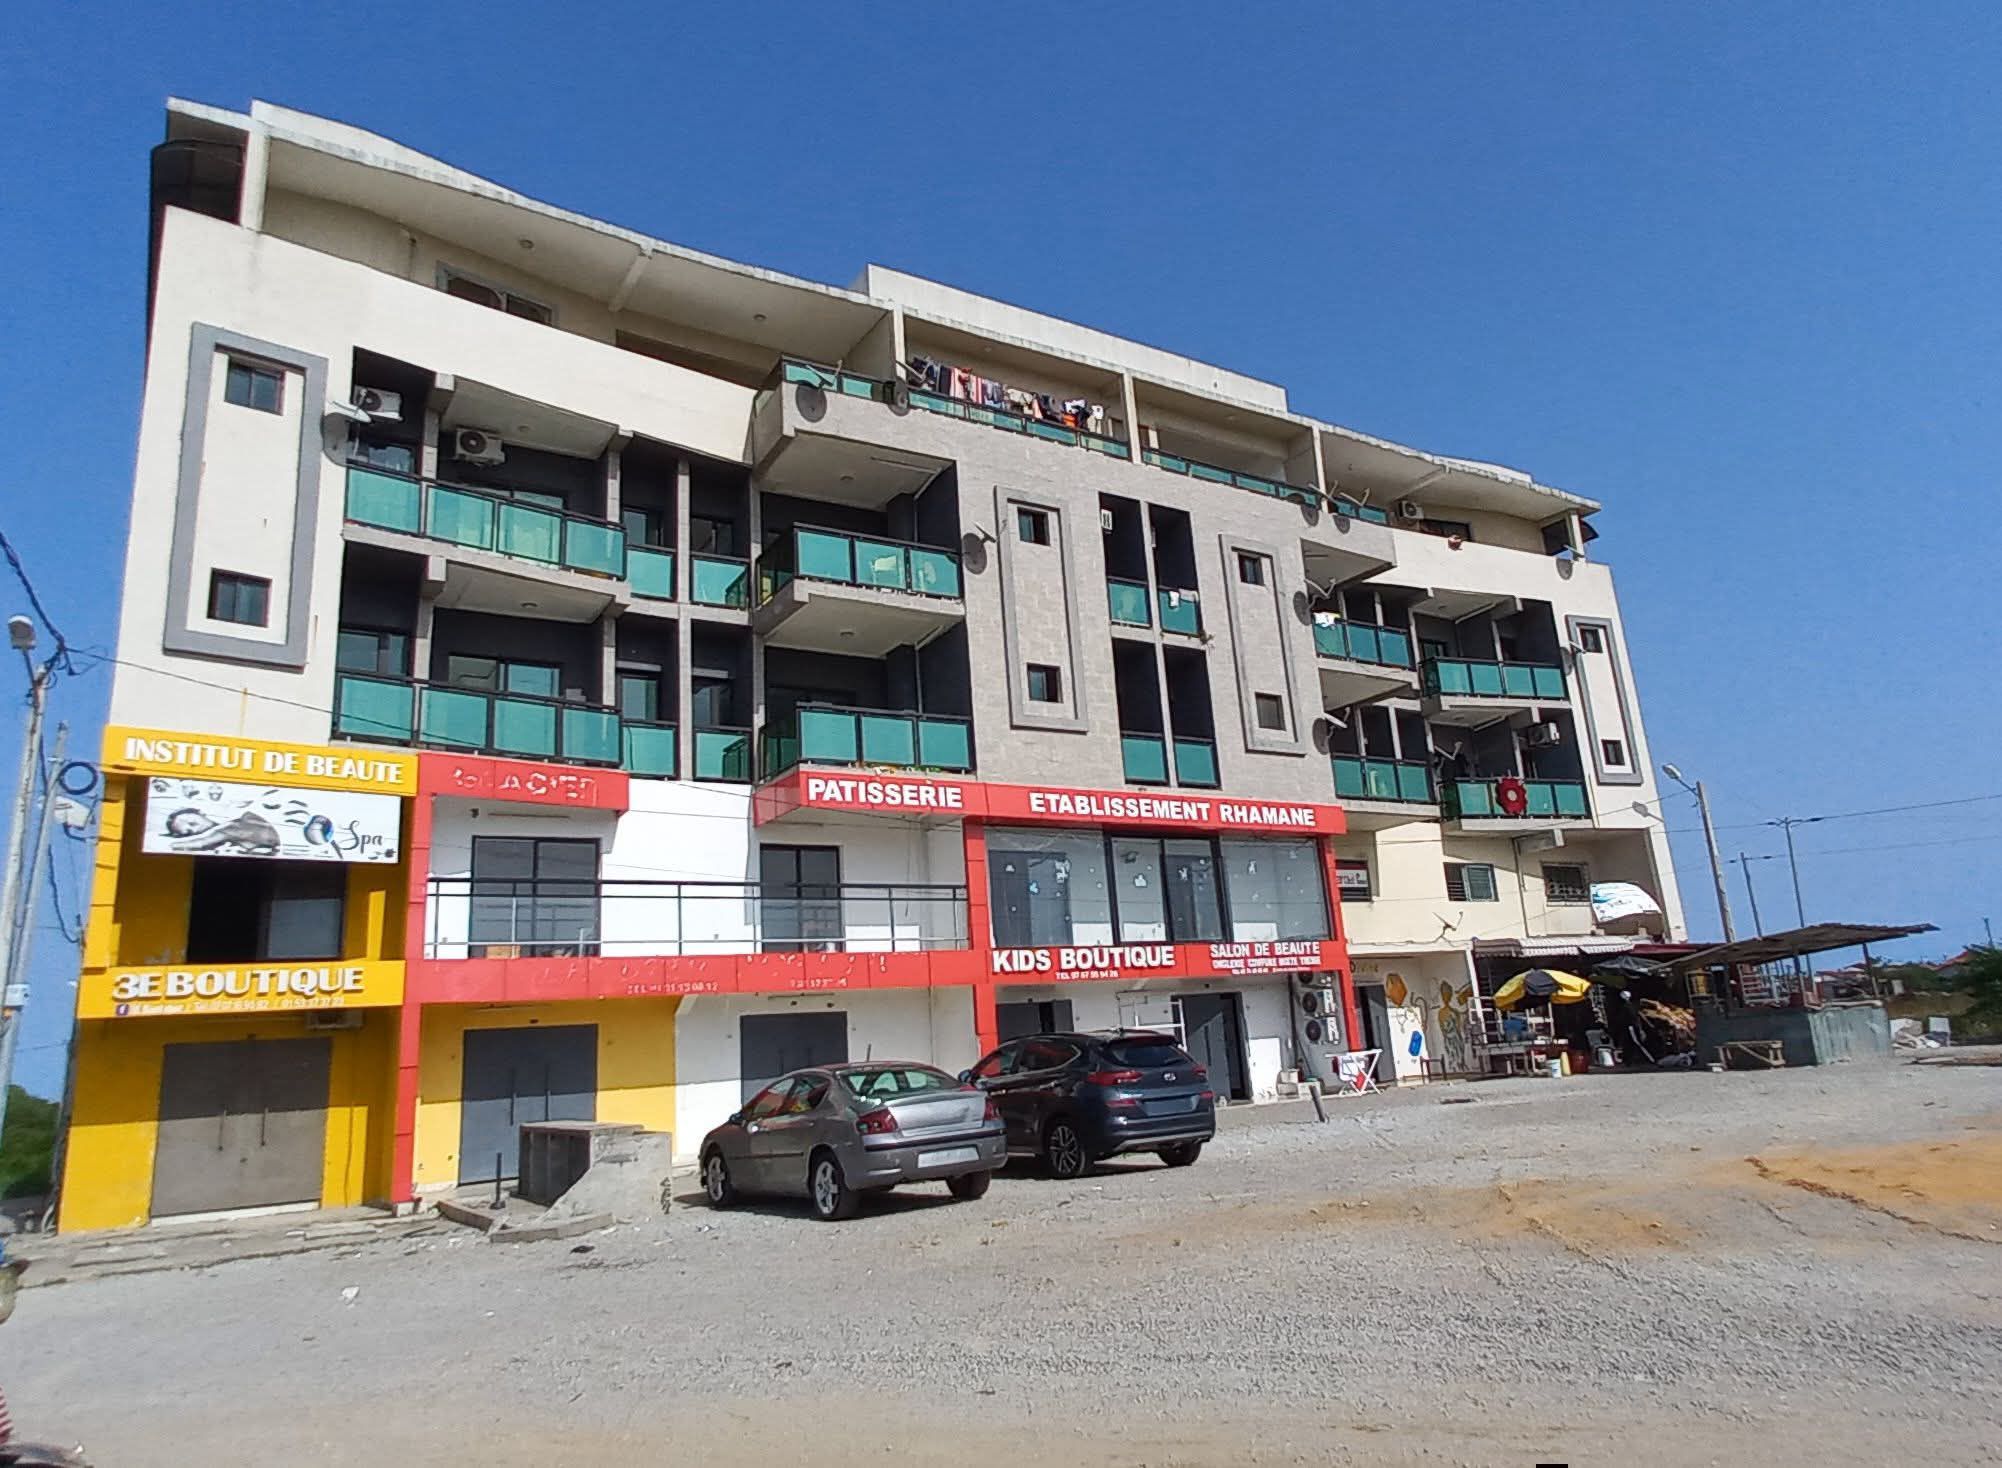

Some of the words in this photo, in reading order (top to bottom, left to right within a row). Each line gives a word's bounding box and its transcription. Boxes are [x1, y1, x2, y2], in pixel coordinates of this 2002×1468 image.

[124, 737, 256, 770] INSTITUT
[263, 752, 300, 774] DE
[307, 754, 404, 784] BEAUTE
[808, 778, 963, 808] PATISSERIE
[1029, 792, 1210, 821] ETABLISSEMENT
[1220, 804, 1316, 826] RHAMANE
[340, 820, 383, 854] Spa
[993, 949, 1052, 973] KIDS
[1060, 946, 1176, 970] BOUTIQUE
[1210, 943, 1250, 958] SALON
[1254, 942, 1270, 957] DE
[1274, 941, 1320, 955] BEAUTE
[113, 972, 162, 1000] 3E
[165, 967, 365, 998] BOUTIQUE
